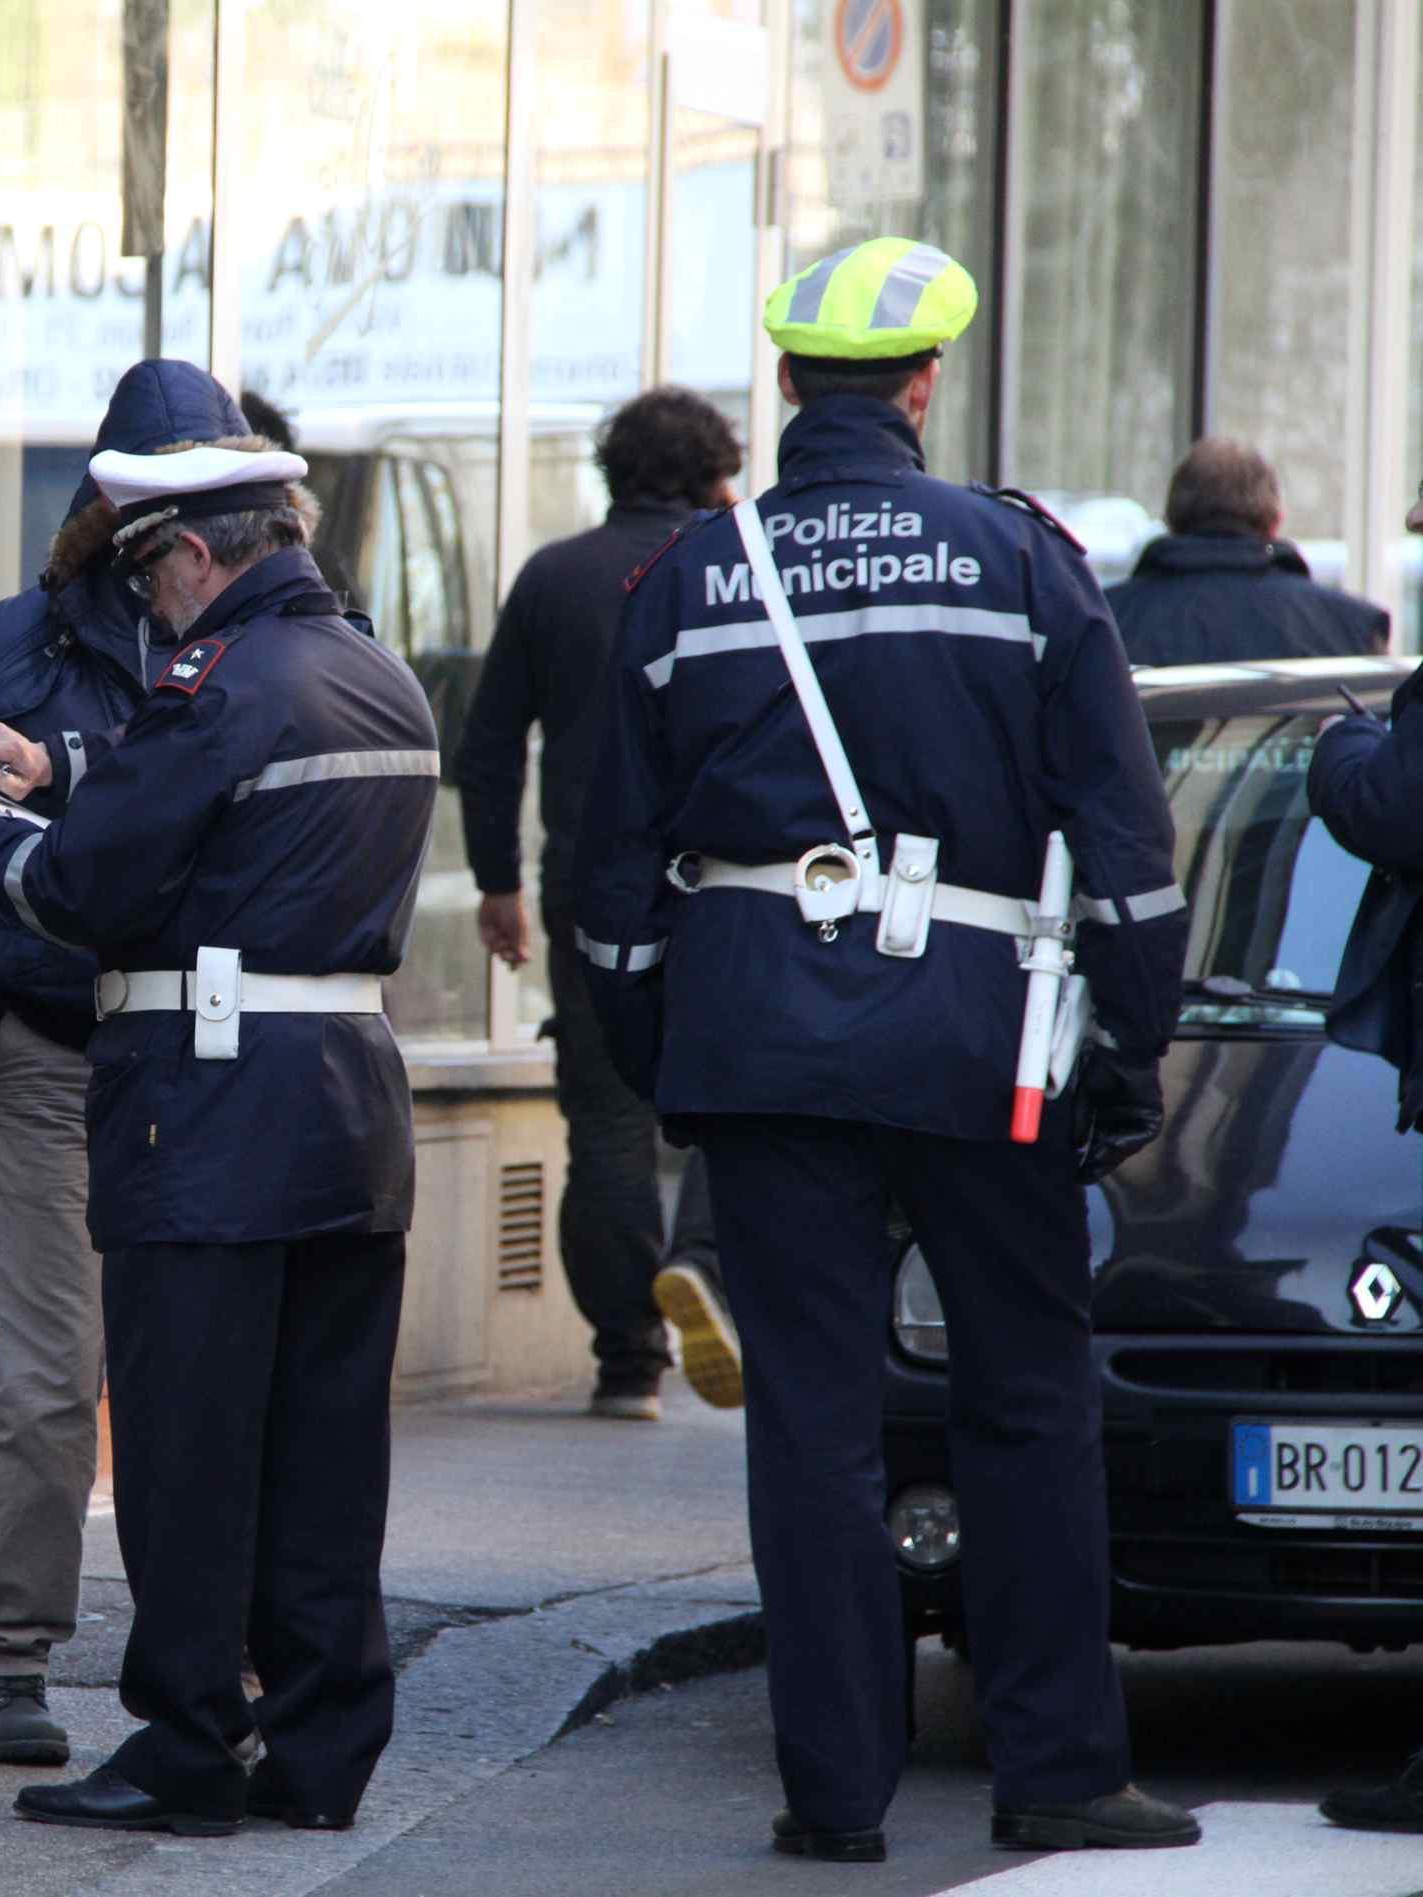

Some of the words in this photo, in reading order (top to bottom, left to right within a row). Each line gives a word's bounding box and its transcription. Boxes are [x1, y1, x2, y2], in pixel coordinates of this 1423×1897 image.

[764, 501, 923, 552] Polizia
[1277, 1442, 1327, 1491] BR
[1343, 1443, 1423, 1492] 012
